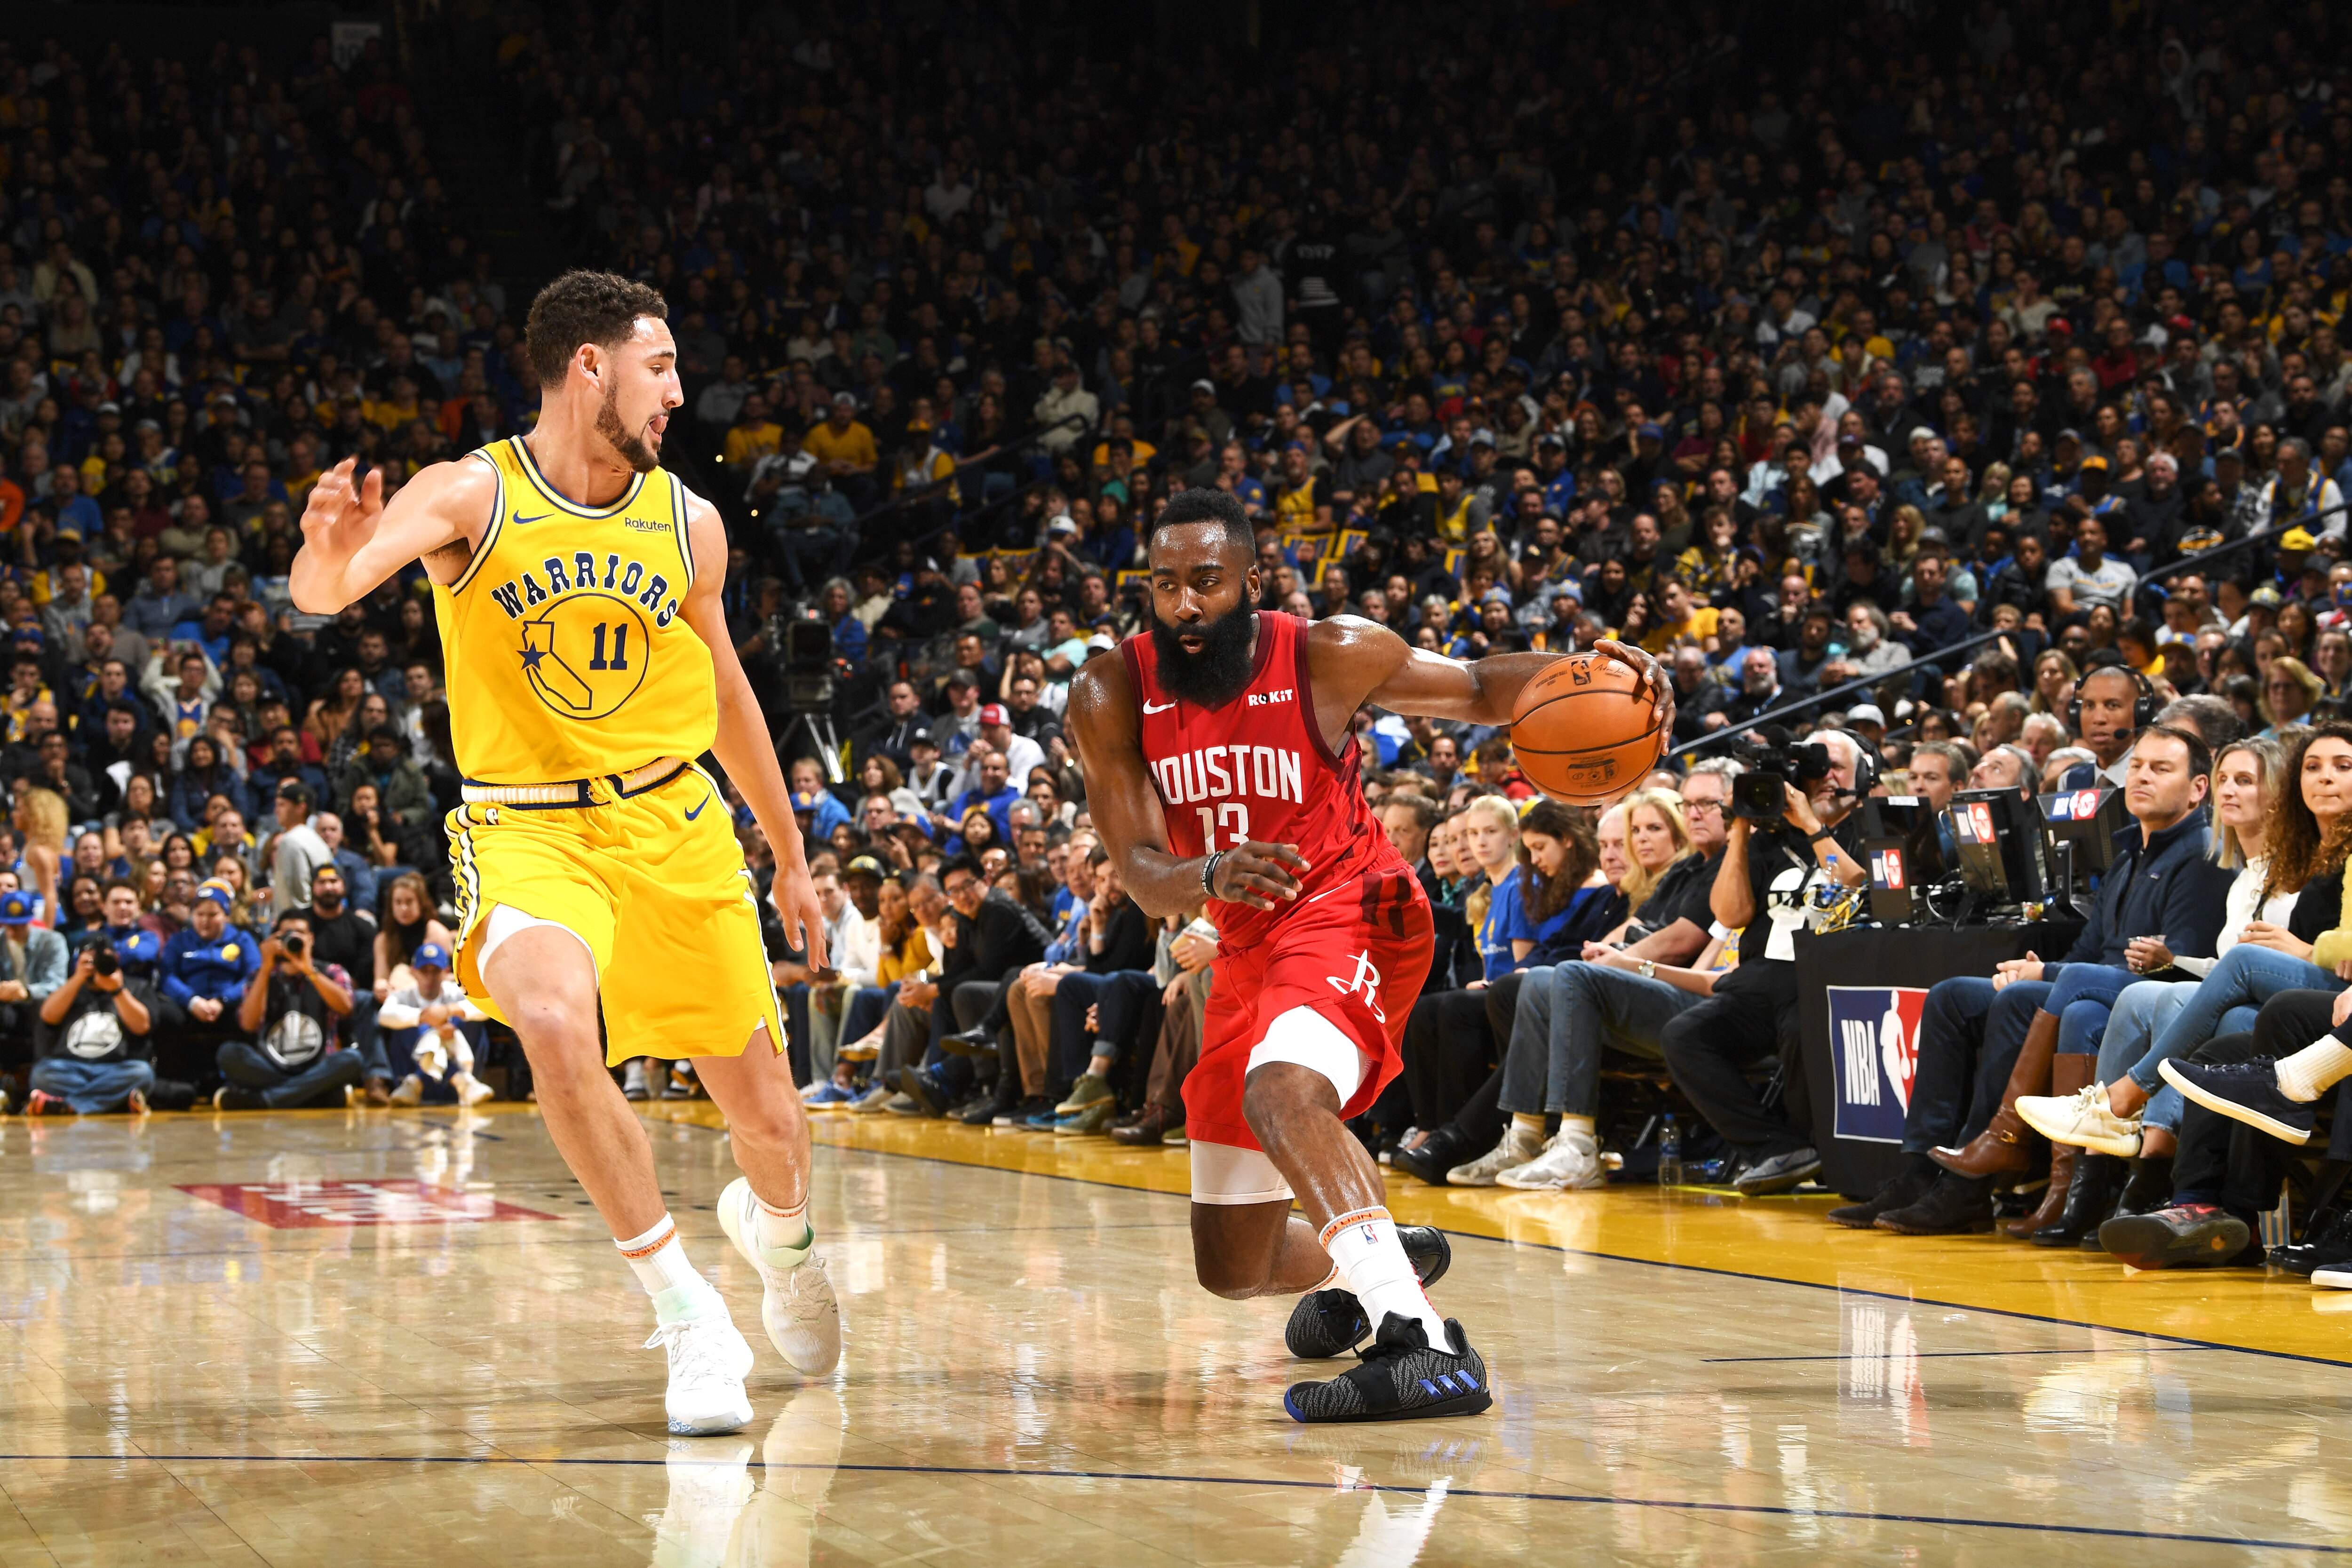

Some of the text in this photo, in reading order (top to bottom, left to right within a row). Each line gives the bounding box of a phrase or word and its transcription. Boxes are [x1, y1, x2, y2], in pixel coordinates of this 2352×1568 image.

[625, 517, 671, 533] Rakuten
[490, 551, 677, 629] WARRIORS
[589, 622, 628, 670] 11
[1196, 803, 1249, 855] 13
[1841, 1019, 1881, 1106] NBA
[1341, 1213, 1372, 1225] NBA
